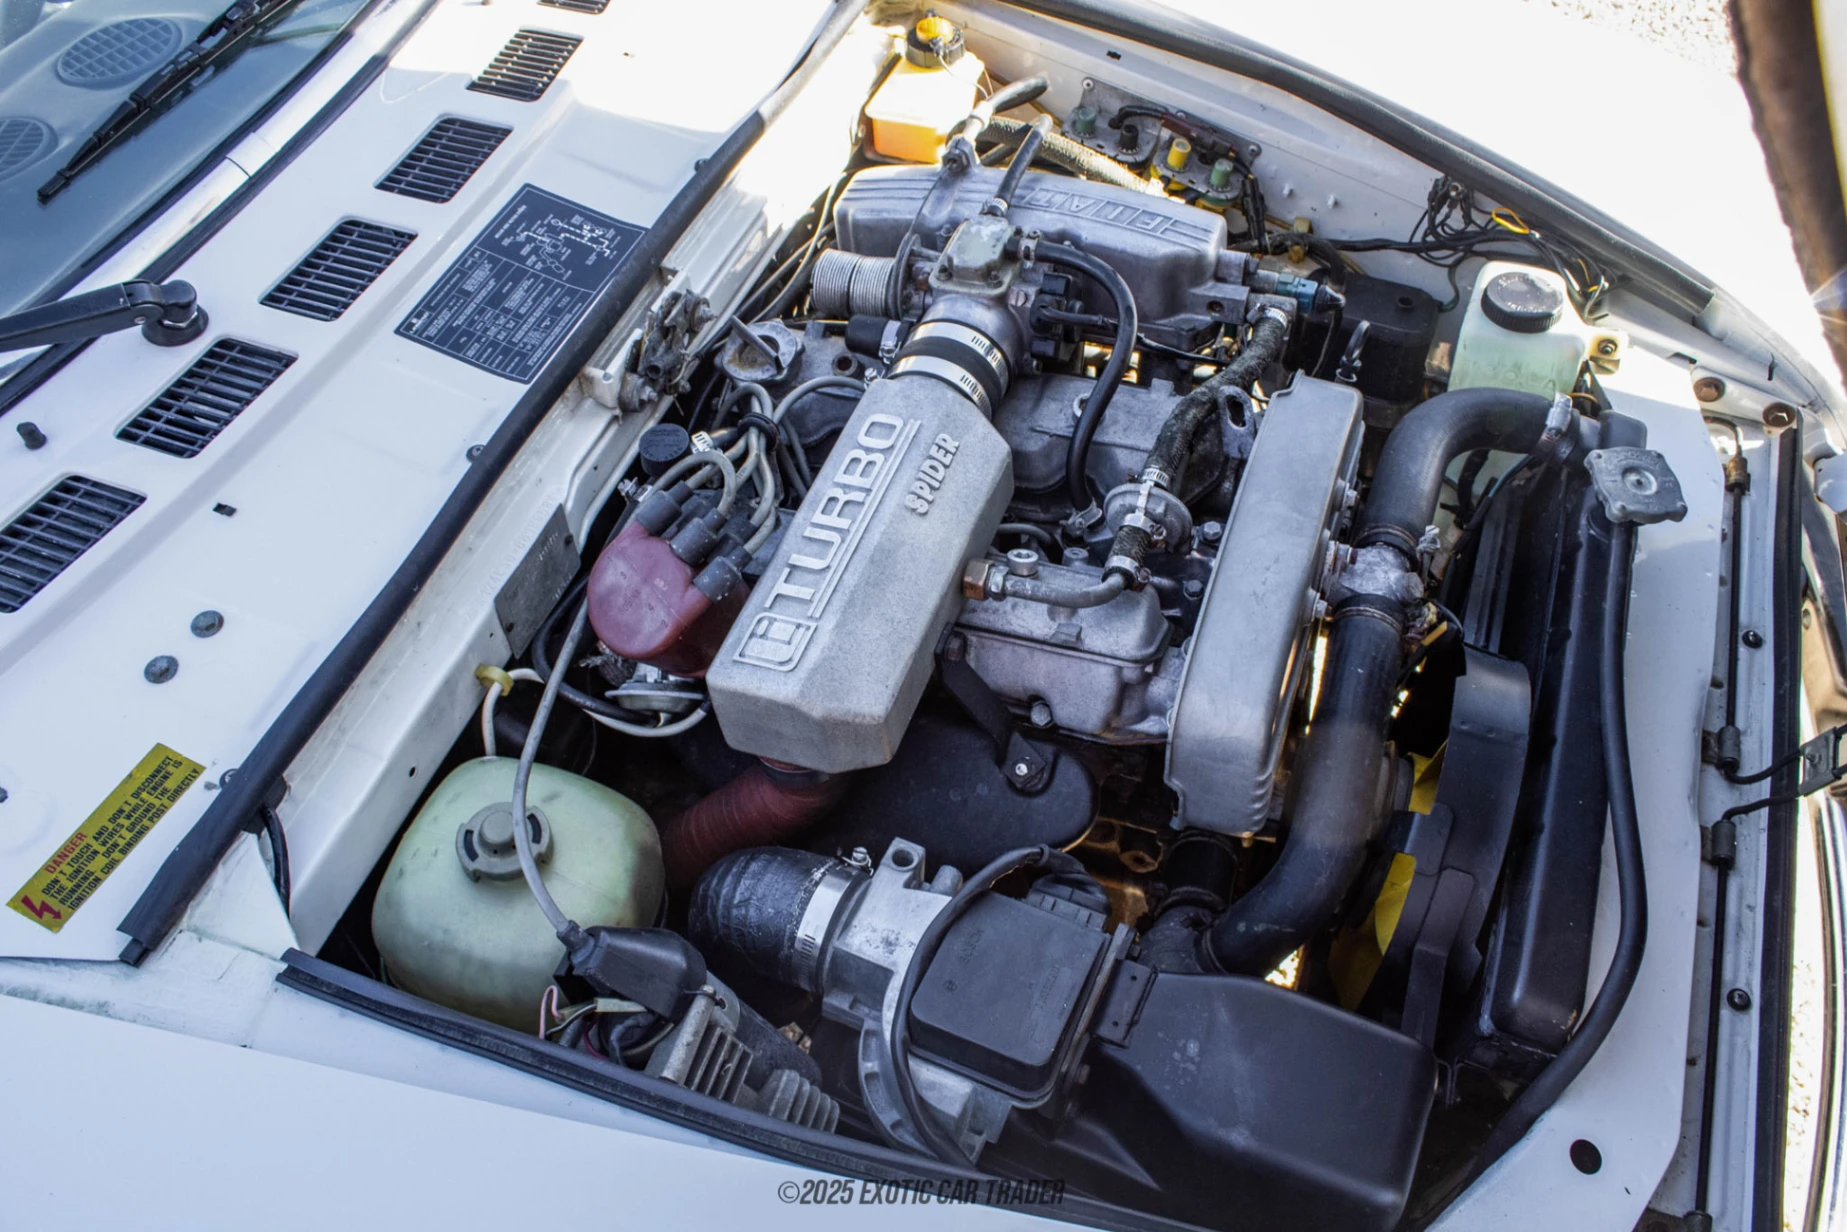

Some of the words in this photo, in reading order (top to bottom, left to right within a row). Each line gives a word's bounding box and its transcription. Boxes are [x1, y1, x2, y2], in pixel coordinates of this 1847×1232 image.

[1030, 196, 1164, 229] FIAT
[764, 413, 904, 608] TURBO
[904, 433, 961, 515] SPIDER
[41, 869, 67, 896] DON'T
[66, 842, 93, 868] TOUCH
[91, 824, 109, 842] AND
[107, 799, 132, 824] DON'T
[130, 755, 173, 799] DISCONNECT
[45, 831, 87, 874] DANGER
[50, 883, 68, 900] THE
[66, 848, 100, 883] IGNITION
[98, 821, 124, 848] WIRES
[123, 796, 148, 821] WHILE
[146, 769, 173, 796] ENGINE
[171, 759, 182, 768] IS
[59, 867, 96, 905] RUNNING.
[101, 833, 126, 859] DON'T
[125, 801, 155, 833] GROUND
[154, 785, 170, 801] THE
[68, 875, 102, 911] IGNITION
[100, 856, 119, 875] COIL
[118, 823, 149, 855] BINDING
[147, 803, 167, 823] POST
[166, 767, 199, 802] DIRECTLY
